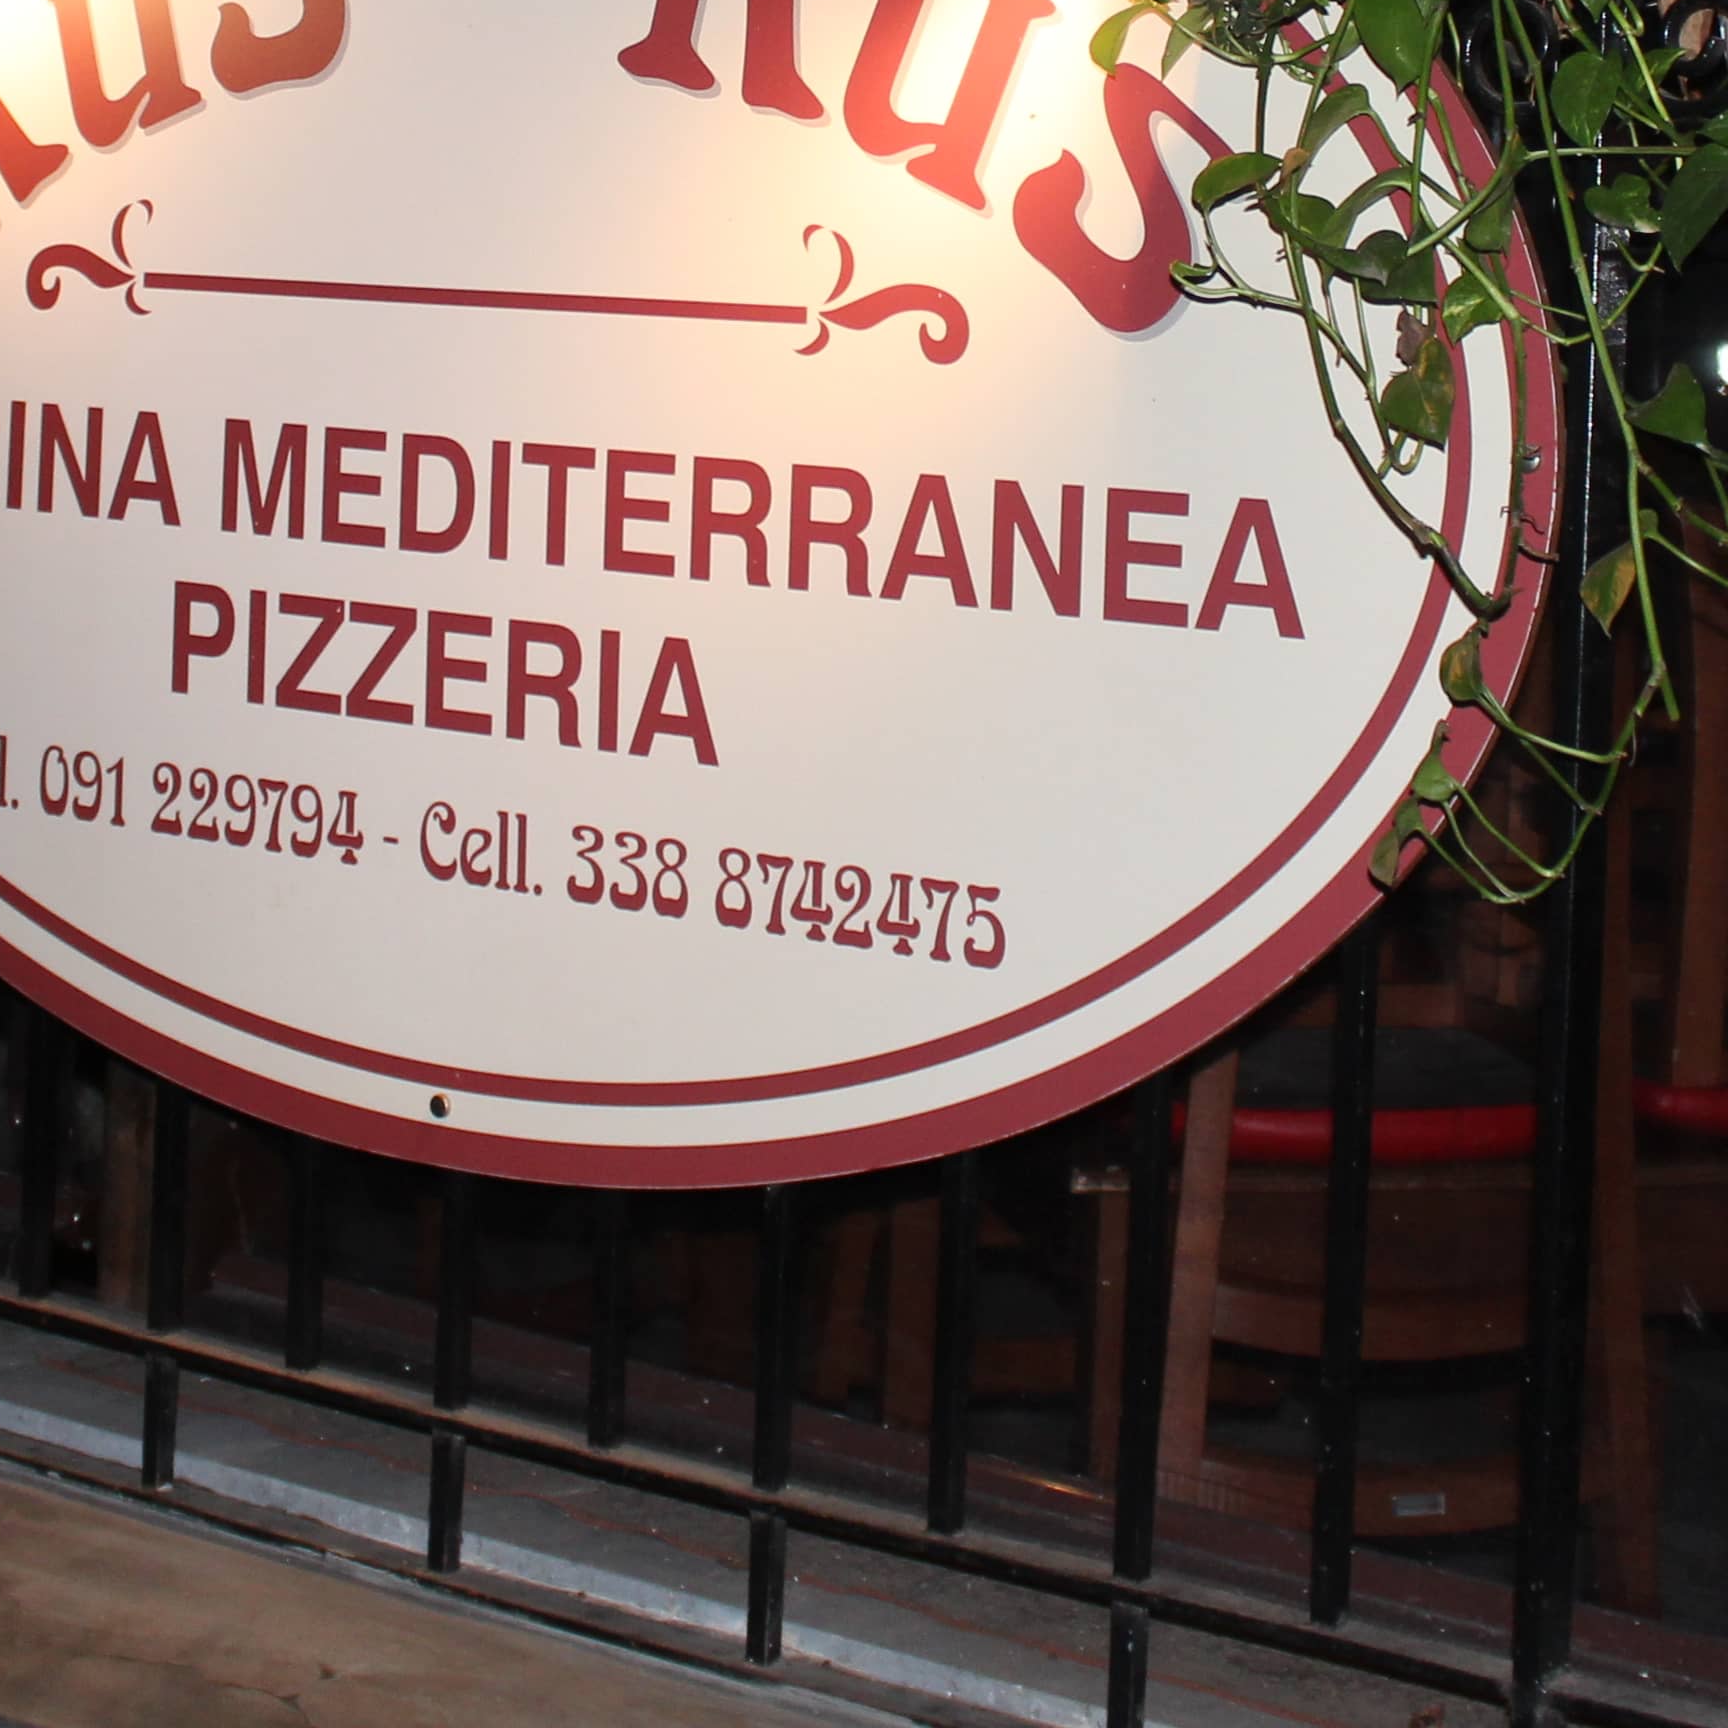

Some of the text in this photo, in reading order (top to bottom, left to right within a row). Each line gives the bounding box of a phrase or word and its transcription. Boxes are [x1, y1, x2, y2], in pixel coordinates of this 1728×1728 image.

[220, 417, 1305, 640] MEDITERRANEA
[171, 580, 719, 767] PIZZERIA
[39, 744, 126, 828] 091
[150, 762, 364, 866] 229794
[419, 801, 544, 896] Cell.
[566, 824, 689, 919] 338
[714, 847, 1006, 970] 8742475
